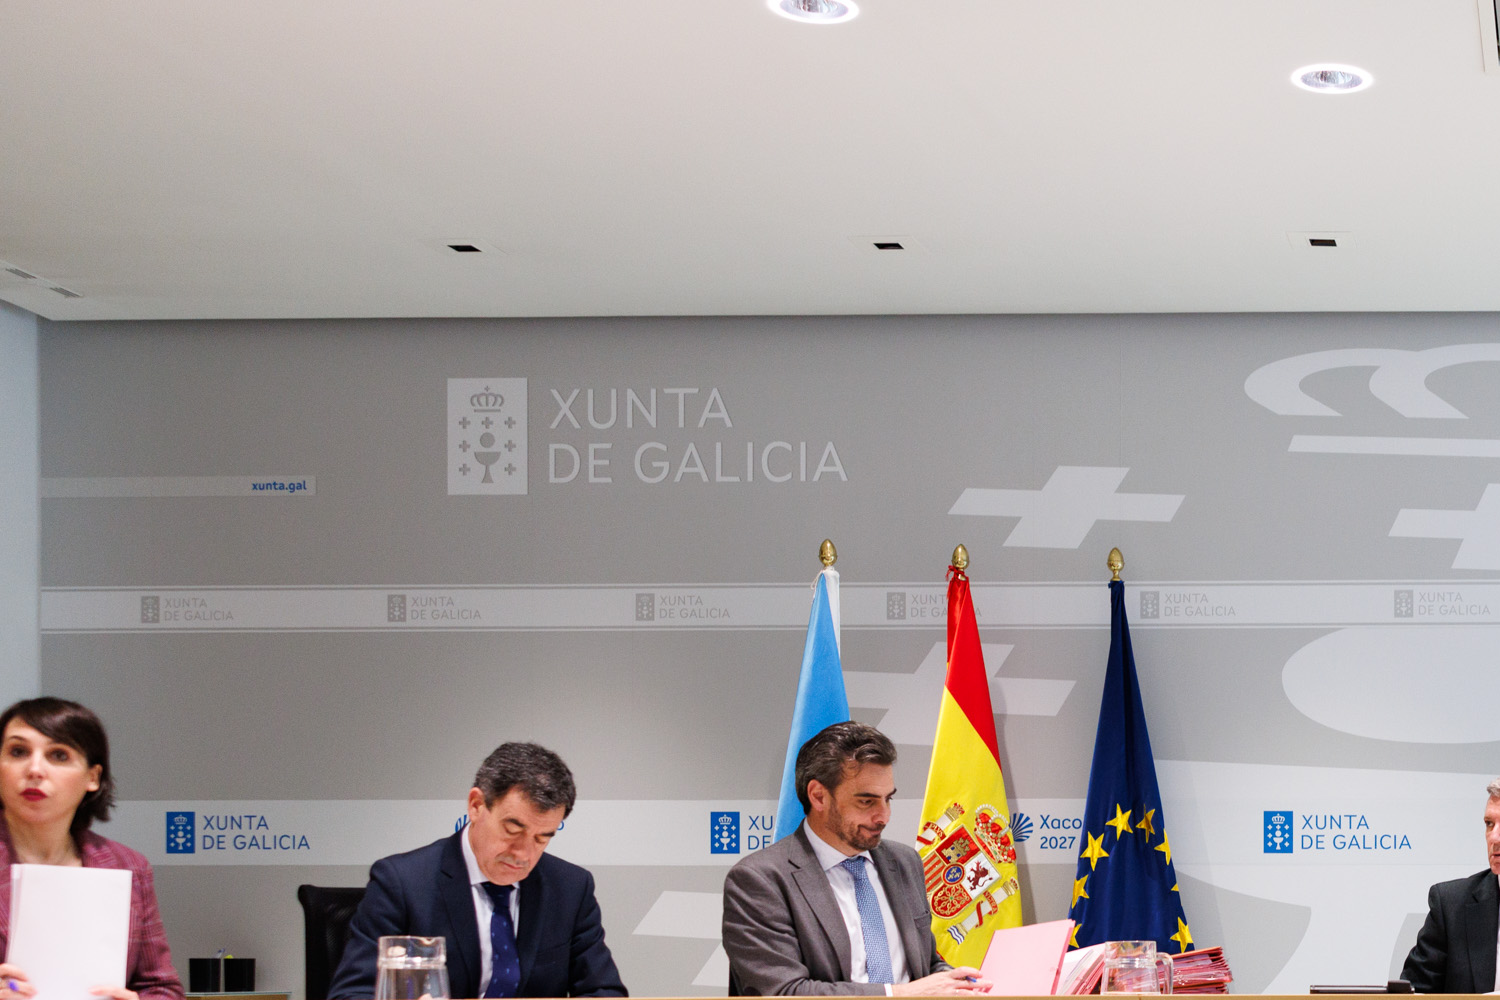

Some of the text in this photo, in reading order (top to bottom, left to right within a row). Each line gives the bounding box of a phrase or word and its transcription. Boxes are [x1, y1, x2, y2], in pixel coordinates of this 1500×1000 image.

[549, 387, 733, 430] XUNTA
[548, 441, 849, 484] DE GALICIA
[252, 480, 307, 493] xunta.gal
[411, 597, 455, 607] XUNTA
[660, 595, 704, 606] XUNTA
[911, 594, 947, 605] XUNT
[1164, 593, 1209, 604] XUNTA
[1419, 591, 1463, 602] XUNTA
[164, 597, 208, 608] XUNTA
[164, 610, 234, 621] DE GALICIA
[410, 609, 482, 620] DE GALICIA
[659, 608, 731, 619] DE GALICIA
[910, 608, 927, 618] DE
[1164, 606, 1237, 617] DE GALICIA
[1418, 604, 1491, 616] DE GALICIA
[203, 815, 269, 831] XUNTA
[1039, 814, 1083, 830] Xaco
[1301, 814, 1370, 830] XUNTA
[202, 834, 311, 850] DE GALICIA
[747, 835, 772, 850] DE
[1040, 836, 1076, 850] 2027
[1301, 834, 1412, 850] DE GALICIA
